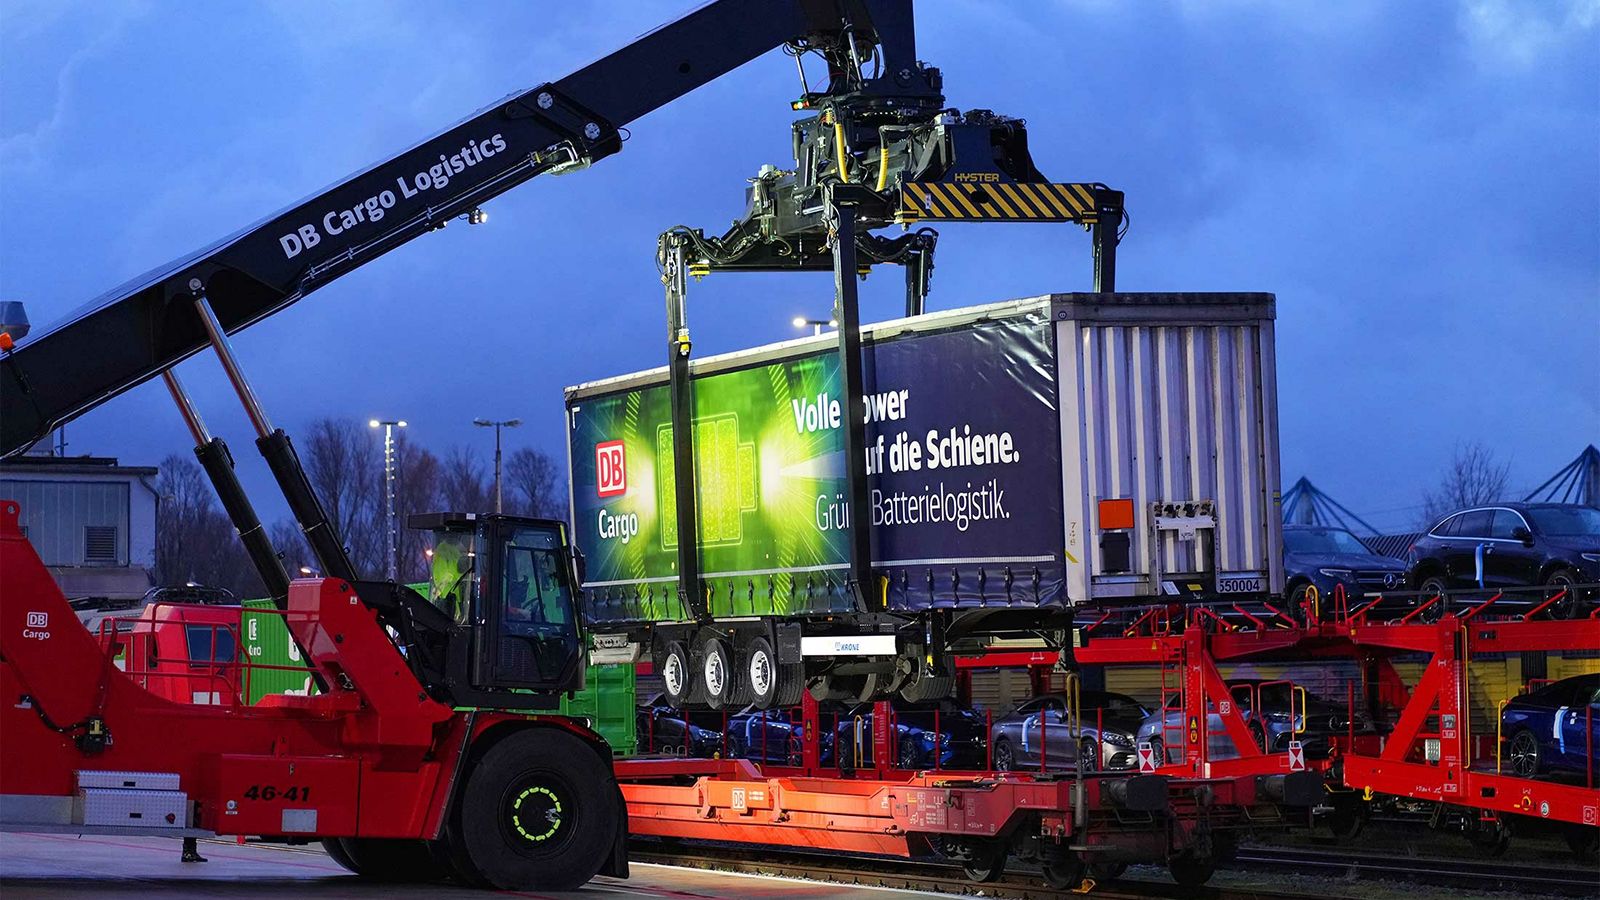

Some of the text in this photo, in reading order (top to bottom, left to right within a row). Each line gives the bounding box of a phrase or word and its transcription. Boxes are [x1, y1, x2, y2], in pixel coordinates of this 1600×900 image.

[954, 172, 1000, 182] HYSTER
[279, 133, 507, 259] DB Cargo Logistics
[792, 388, 909, 433] Volle ower
[865, 424, 1020, 475] uf die Schiene.
[600, 448, 623, 489] DB
[871, 478, 1010, 532] Batterielogistik.
[598, 509, 639, 544] Cargo
[1220, 580, 1260, 592] 550004
[29, 614, 45, 625] DB
[23, 629, 50, 640] Cargo
[841, 643, 860, 651] KRONE
[243, 785, 311, 801] 46-41
